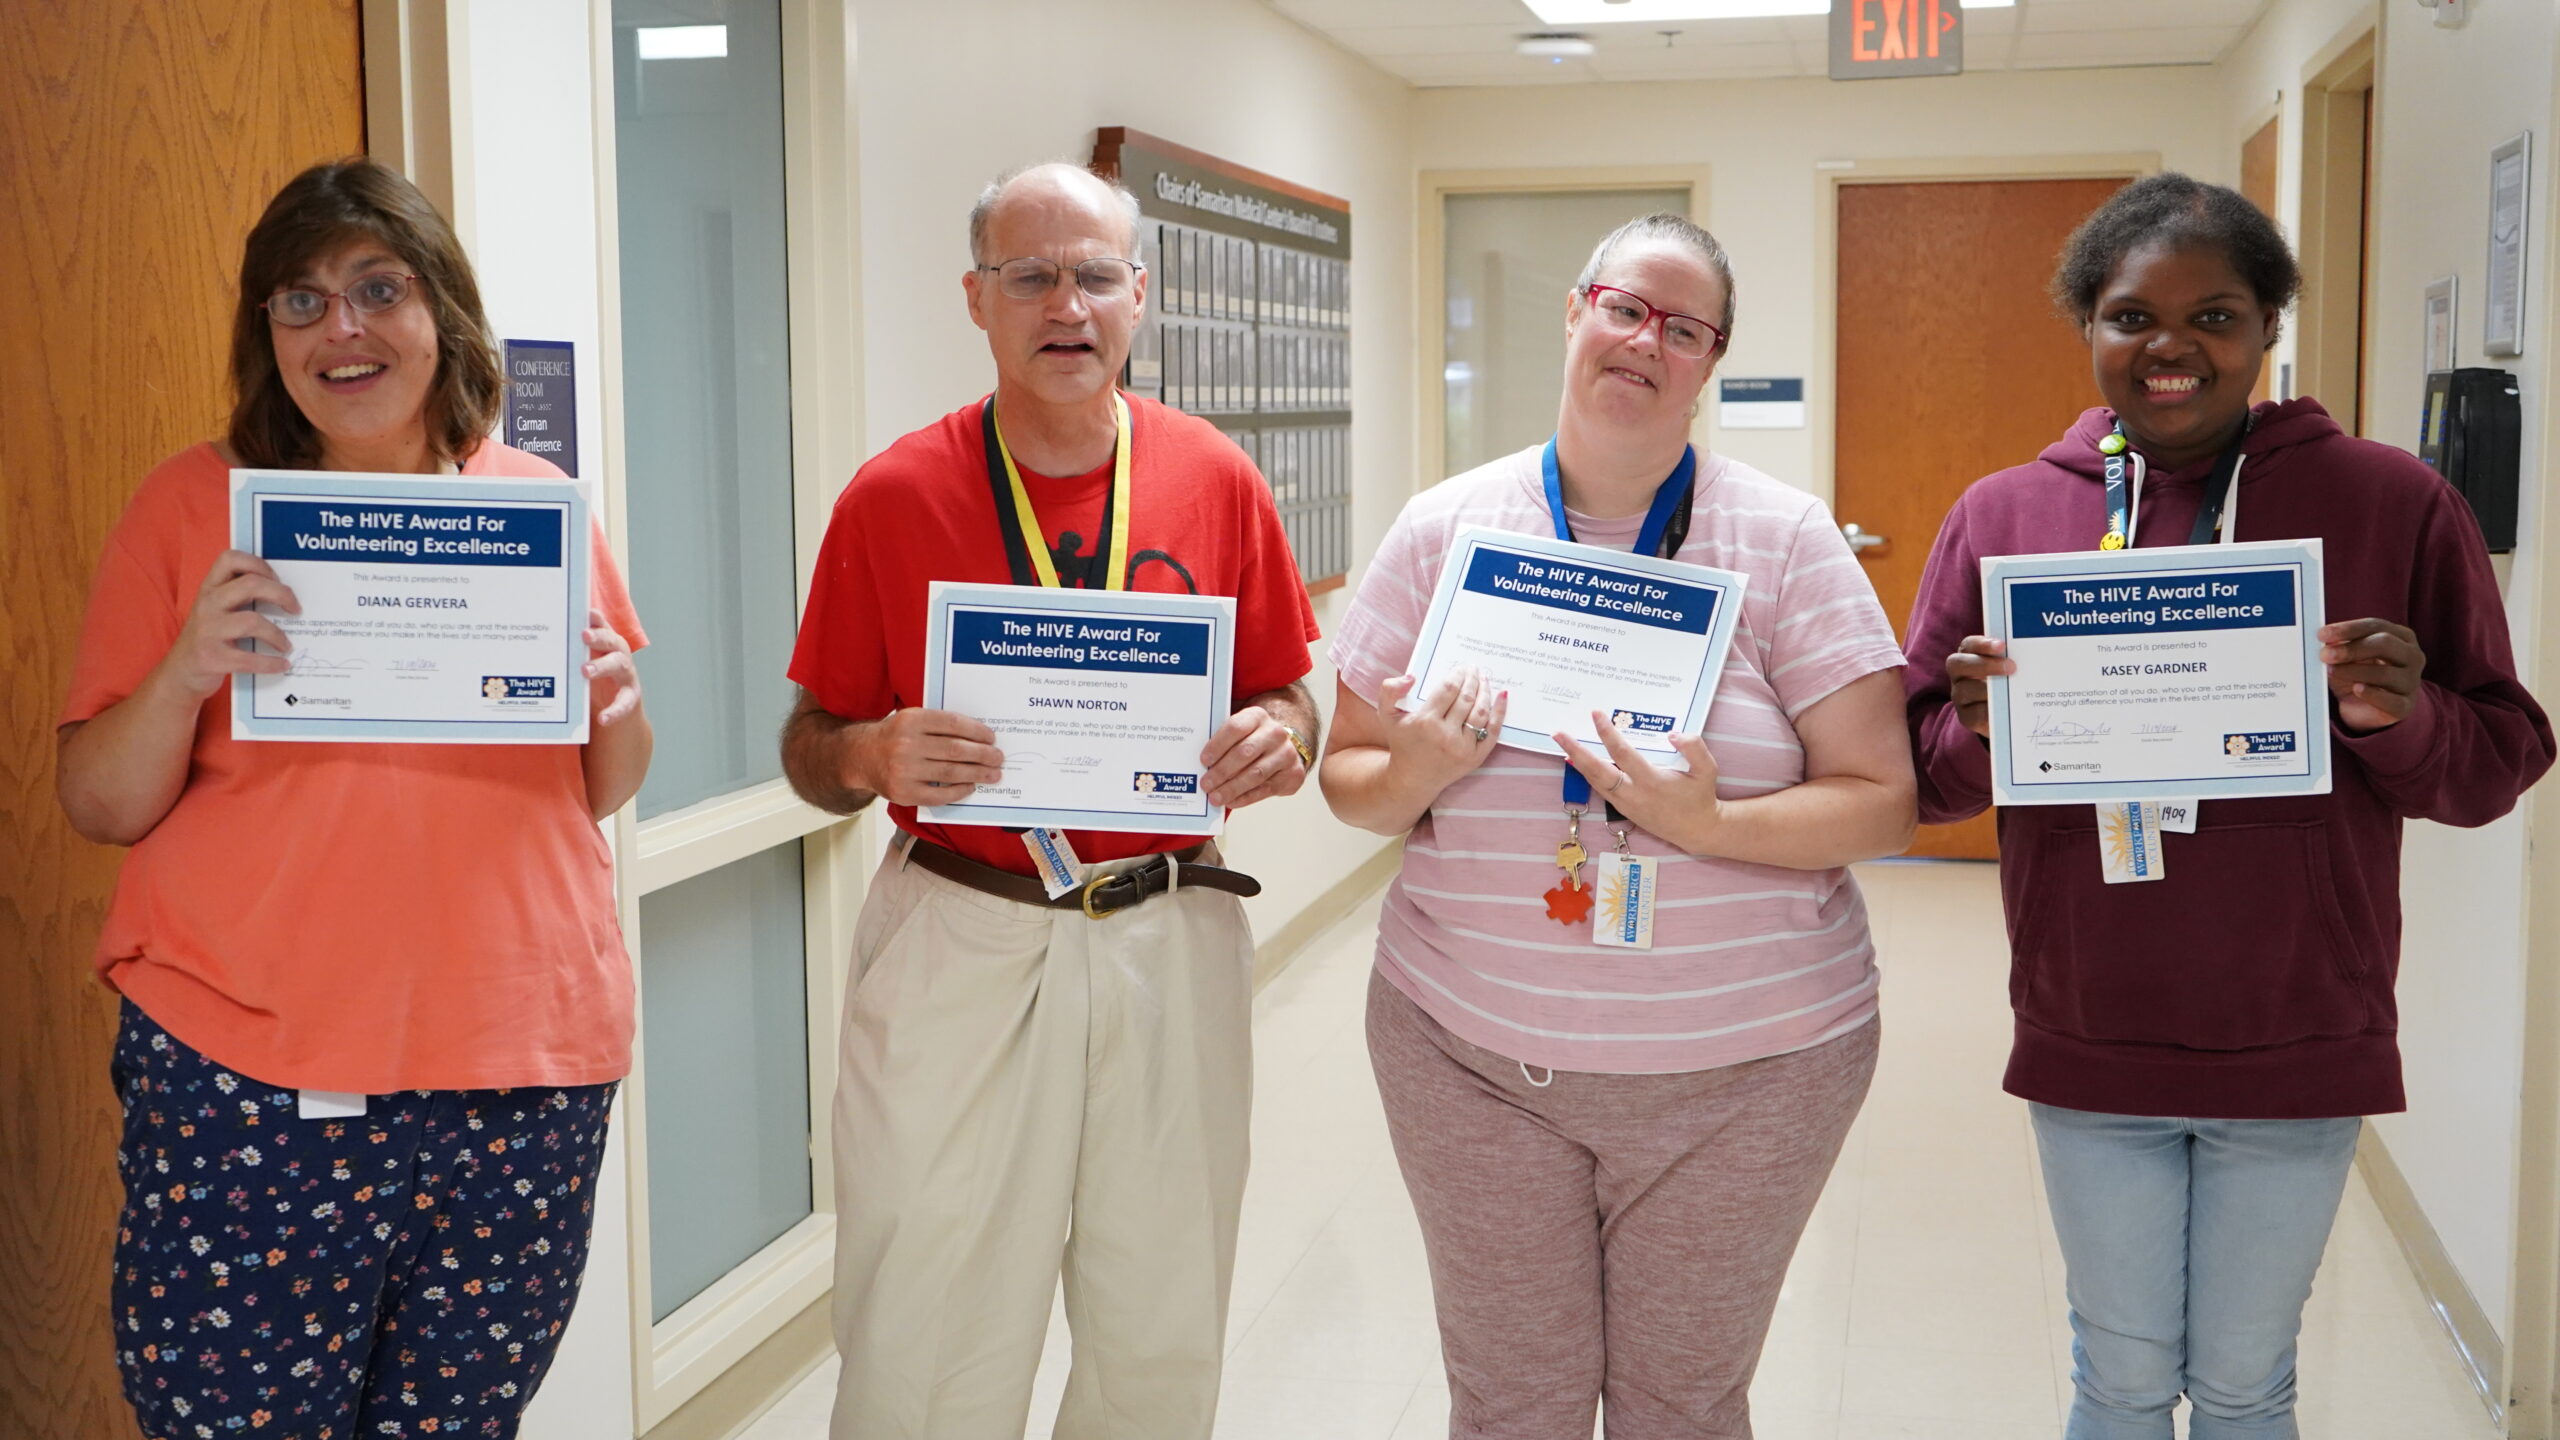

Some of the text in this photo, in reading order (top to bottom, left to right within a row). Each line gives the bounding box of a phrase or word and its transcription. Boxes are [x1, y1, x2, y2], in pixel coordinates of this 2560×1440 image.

[1157, 171, 1185, 205] Chairs
[1196, 182, 1234, 217] Samaritan
[515, 360, 571, 376] CONFERENCE
[516, 382, 544, 397] ROOM
[516, 415, 548, 431] Carman
[517, 437, 562, 453] Conference
[319, 510, 505, 531] The HIVE Award For
[294, 533, 529, 556] Volunteering Excellence
[1518, 561, 1668, 600] The HIVE Award For
[1494, 574, 1682, 621] Volunteering Excellence
[2063, 582, 2239, 603] The HIVE Award For
[357, 595, 467, 608] DIANA GERVERA
[2041, 604, 2263, 625] Volunteering Excellence
[1002, 620, 1160, 642] The HIVE Award For
[1538, 632, 1609, 653] SHERI BAKER
[2114, 643, 2141, 651] Award
[2151, 641, 2195, 650] presented
[2197, 640, 2207, 648] to
[980, 640, 1180, 664] Volunteering Excellence
[2101, 662, 2207, 675] KASEY GARDNER
[508, 678, 551, 687] The HIVE
[1077, 680, 1117, 688] presented
[299, 696, 351, 705] Samaritan
[1028, 696, 1127, 711] SHAWN NORTON
[1636, 714, 1671, 725] The HIVE
[1639, 721, 1664, 731] Award
[2249, 733, 2291, 743] The HIVE
[2257, 742, 2284, 750] Award
[2053, 762, 2101, 770] Samaritan
[1157, 775, 1193, 784] The HIVE
[1163, 783, 1187, 791] Award
[978, 785, 1021, 794] Samaritan
[2161, 806, 2186, 823] 1409
[1626, 865, 1640, 940] WORKFORCE
[1639, 876, 1653, 934] VOLUNTEER
